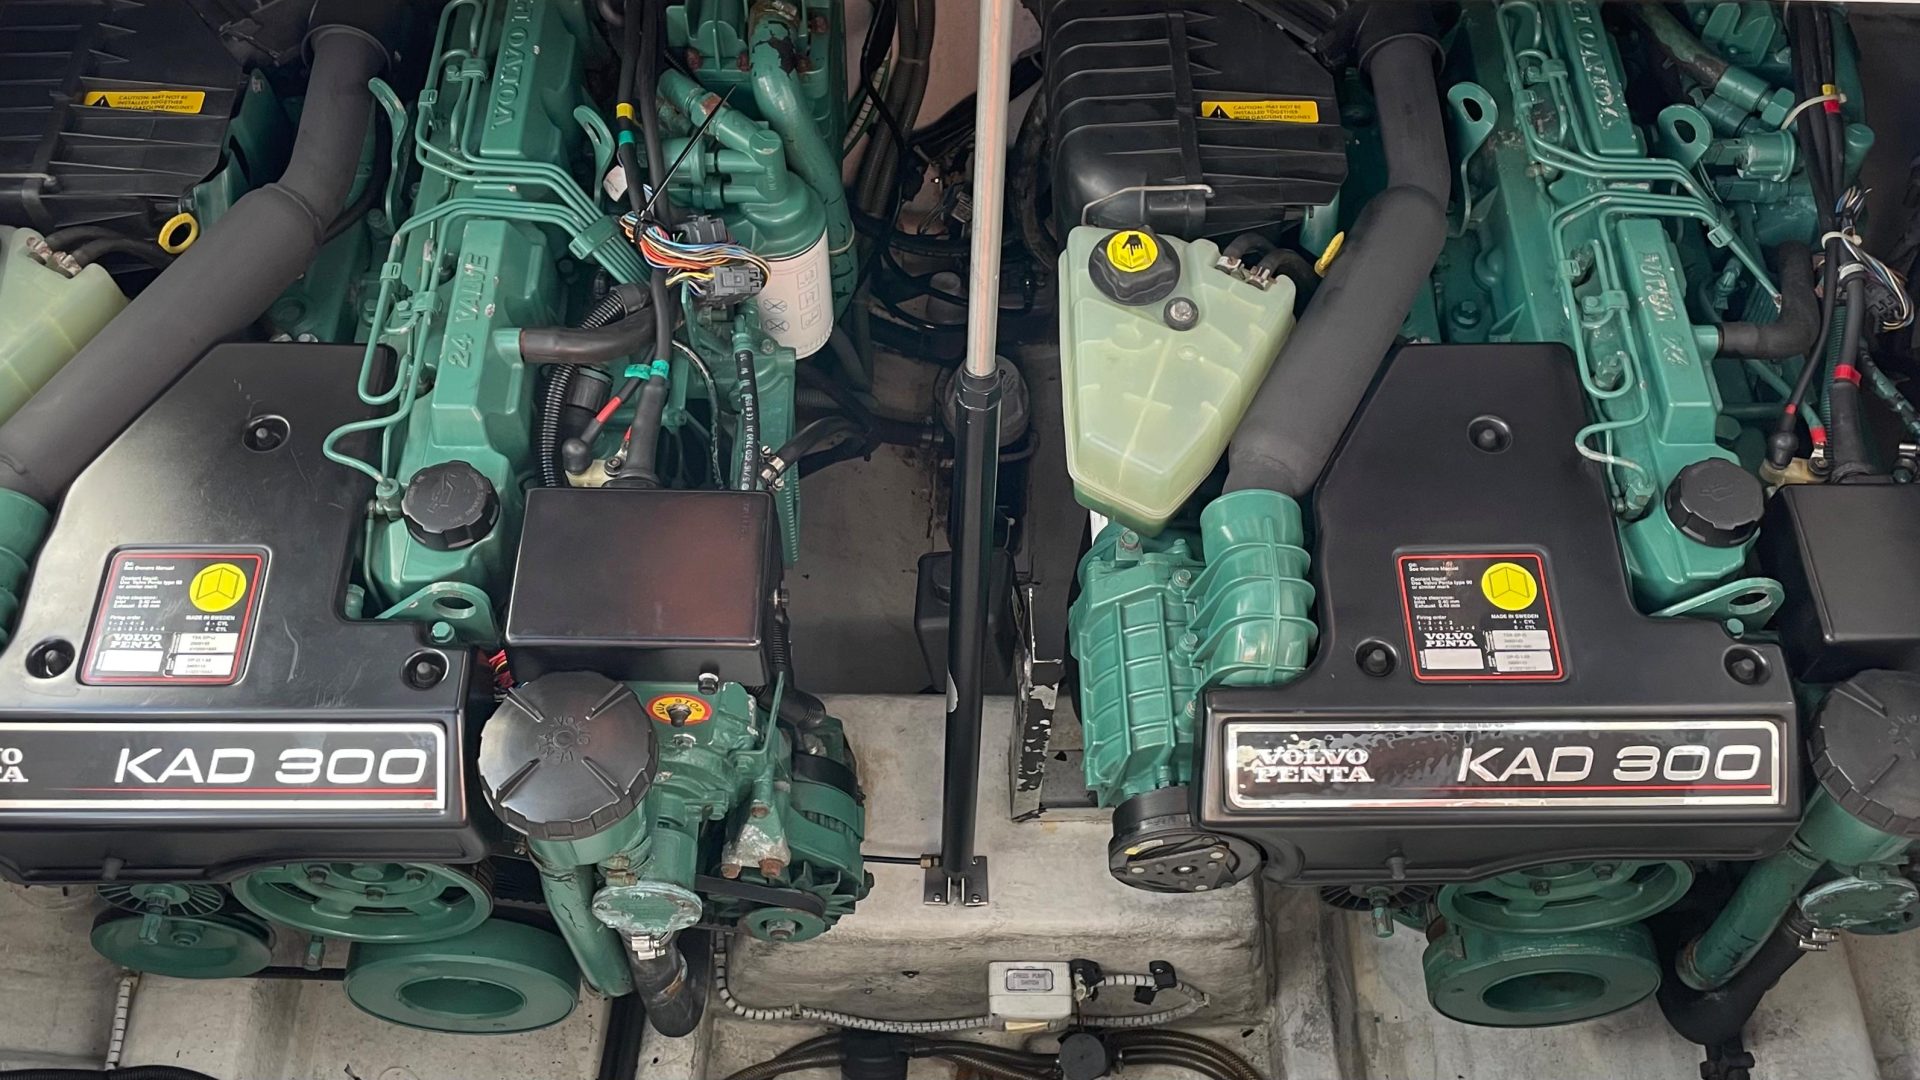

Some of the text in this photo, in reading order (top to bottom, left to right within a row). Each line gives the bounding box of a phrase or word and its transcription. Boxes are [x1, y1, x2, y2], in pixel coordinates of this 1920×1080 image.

[490, 27, 529, 130] VOLVO
[447, 252, 488, 368] 24 VALVE
[674, 698, 703, 712] STOP
[114, 748, 427, 784] KAD 300
[1255, 766, 1375, 783] PENTA
[1256, 748, 1369, 766] VOLVO
[1457, 745, 1762, 782] KAD 300
